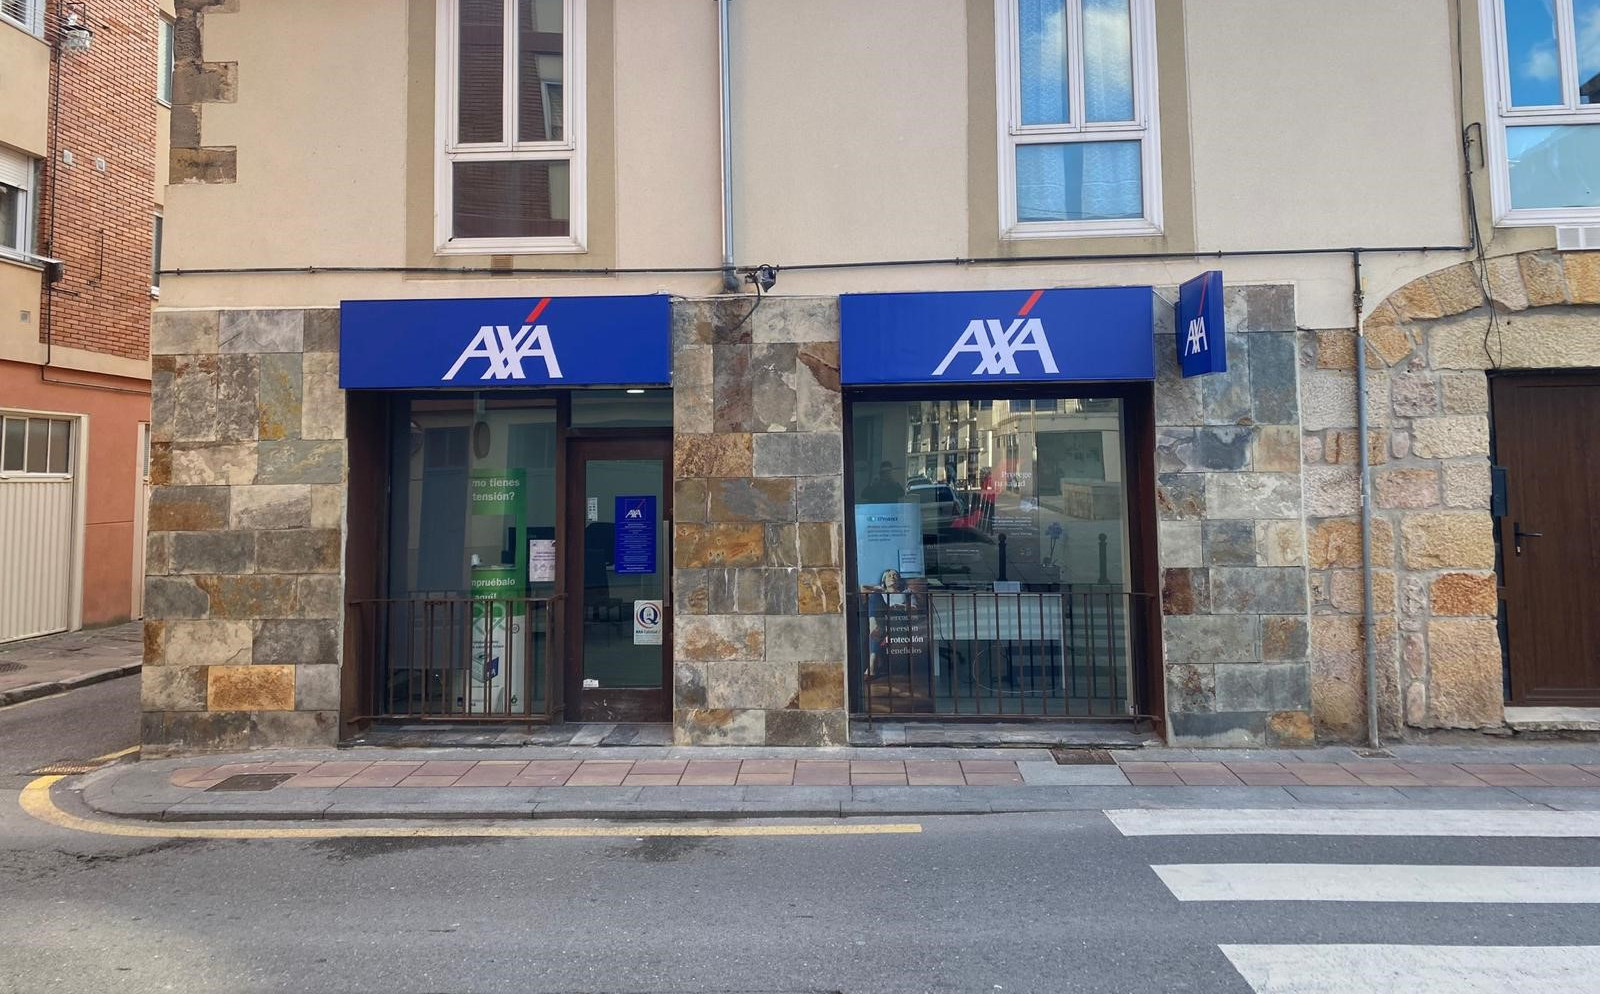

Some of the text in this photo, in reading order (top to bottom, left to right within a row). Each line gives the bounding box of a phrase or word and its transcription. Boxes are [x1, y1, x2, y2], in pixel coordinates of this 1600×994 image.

[931, 318, 1060, 375] AXA
[1185, 316, 1208, 357] AXA
[441, 324, 563, 380] AXA
[489, 477, 520, 487] tienes
[472, 491, 515, 501] tensión?
[625, 509, 642, 519] AXA
